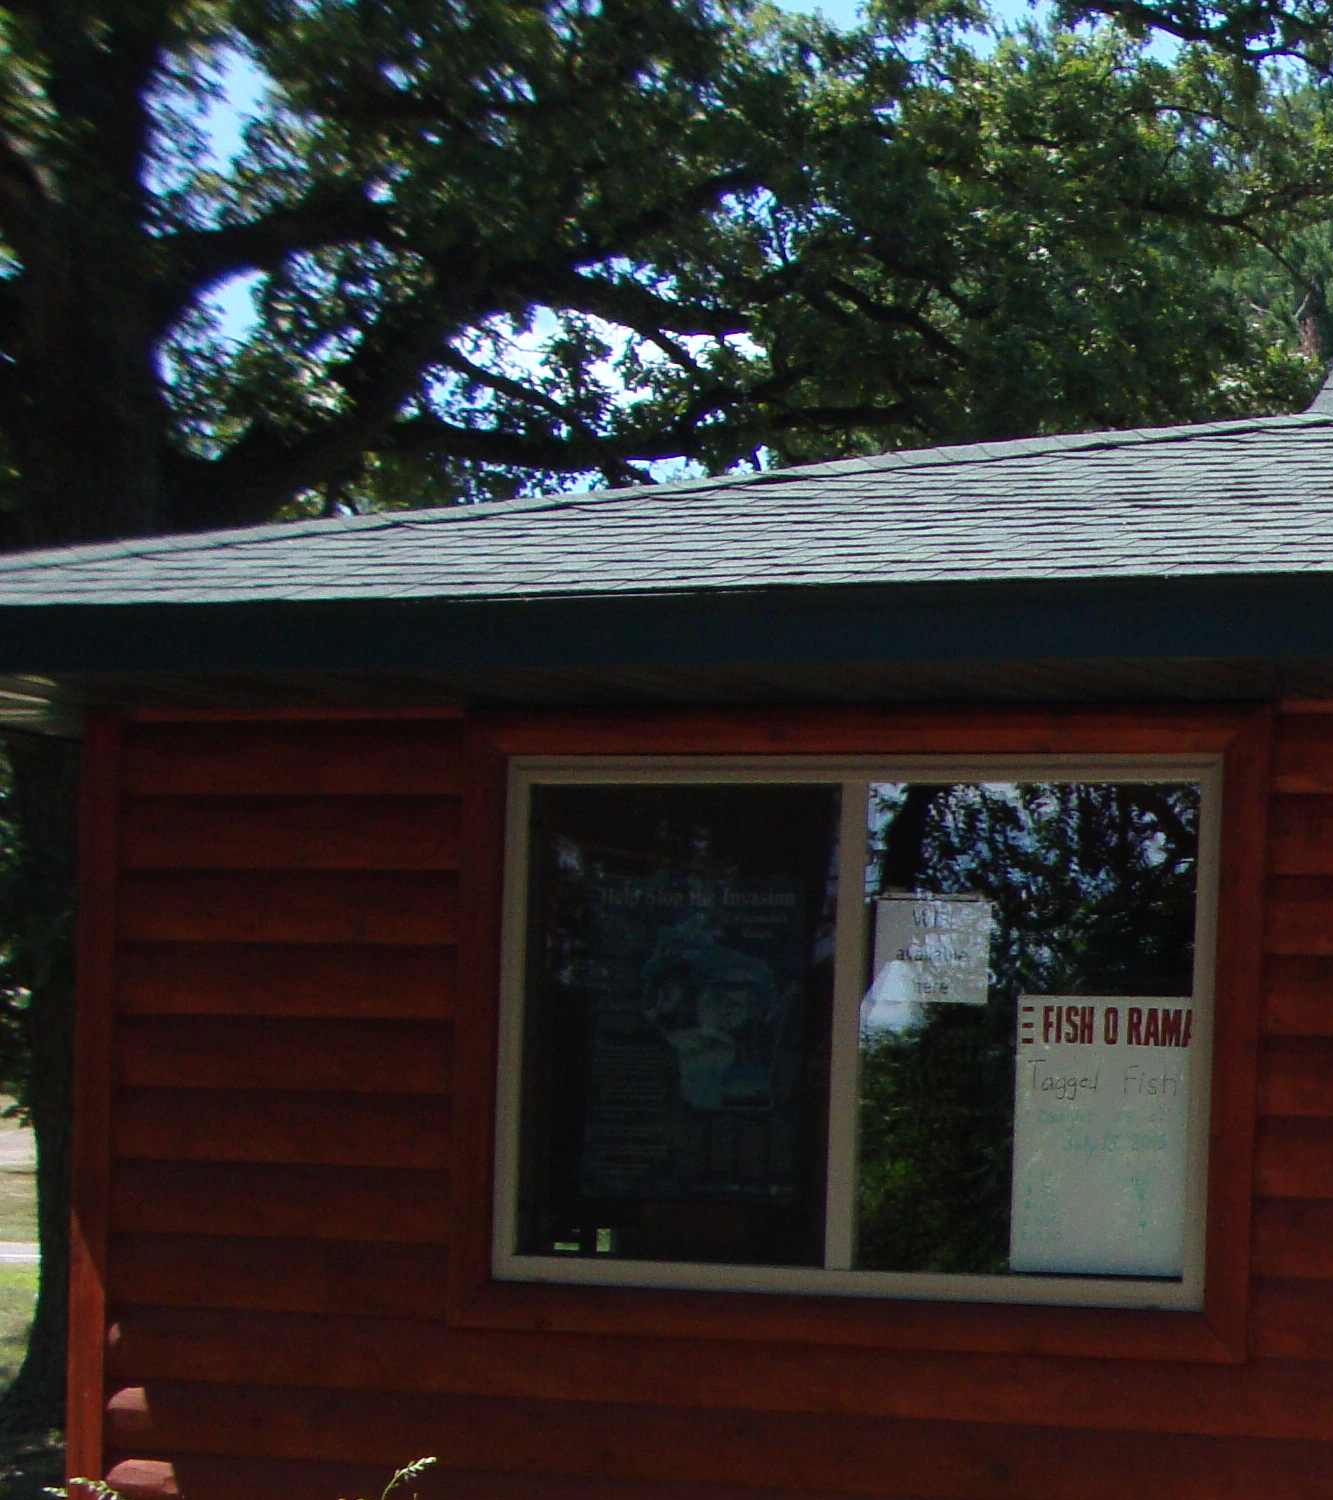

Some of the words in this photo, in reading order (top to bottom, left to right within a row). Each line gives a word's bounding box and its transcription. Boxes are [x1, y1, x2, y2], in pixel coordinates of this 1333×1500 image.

[723, 887, 795, 907] Invasion
[1043, 1005, 1095, 1044] FISH
[1104, 1006, 1118, 1045] O
[1028, 1059, 1099, 1101] Tagged
[1123, 1065, 1177, 1096] Fish
